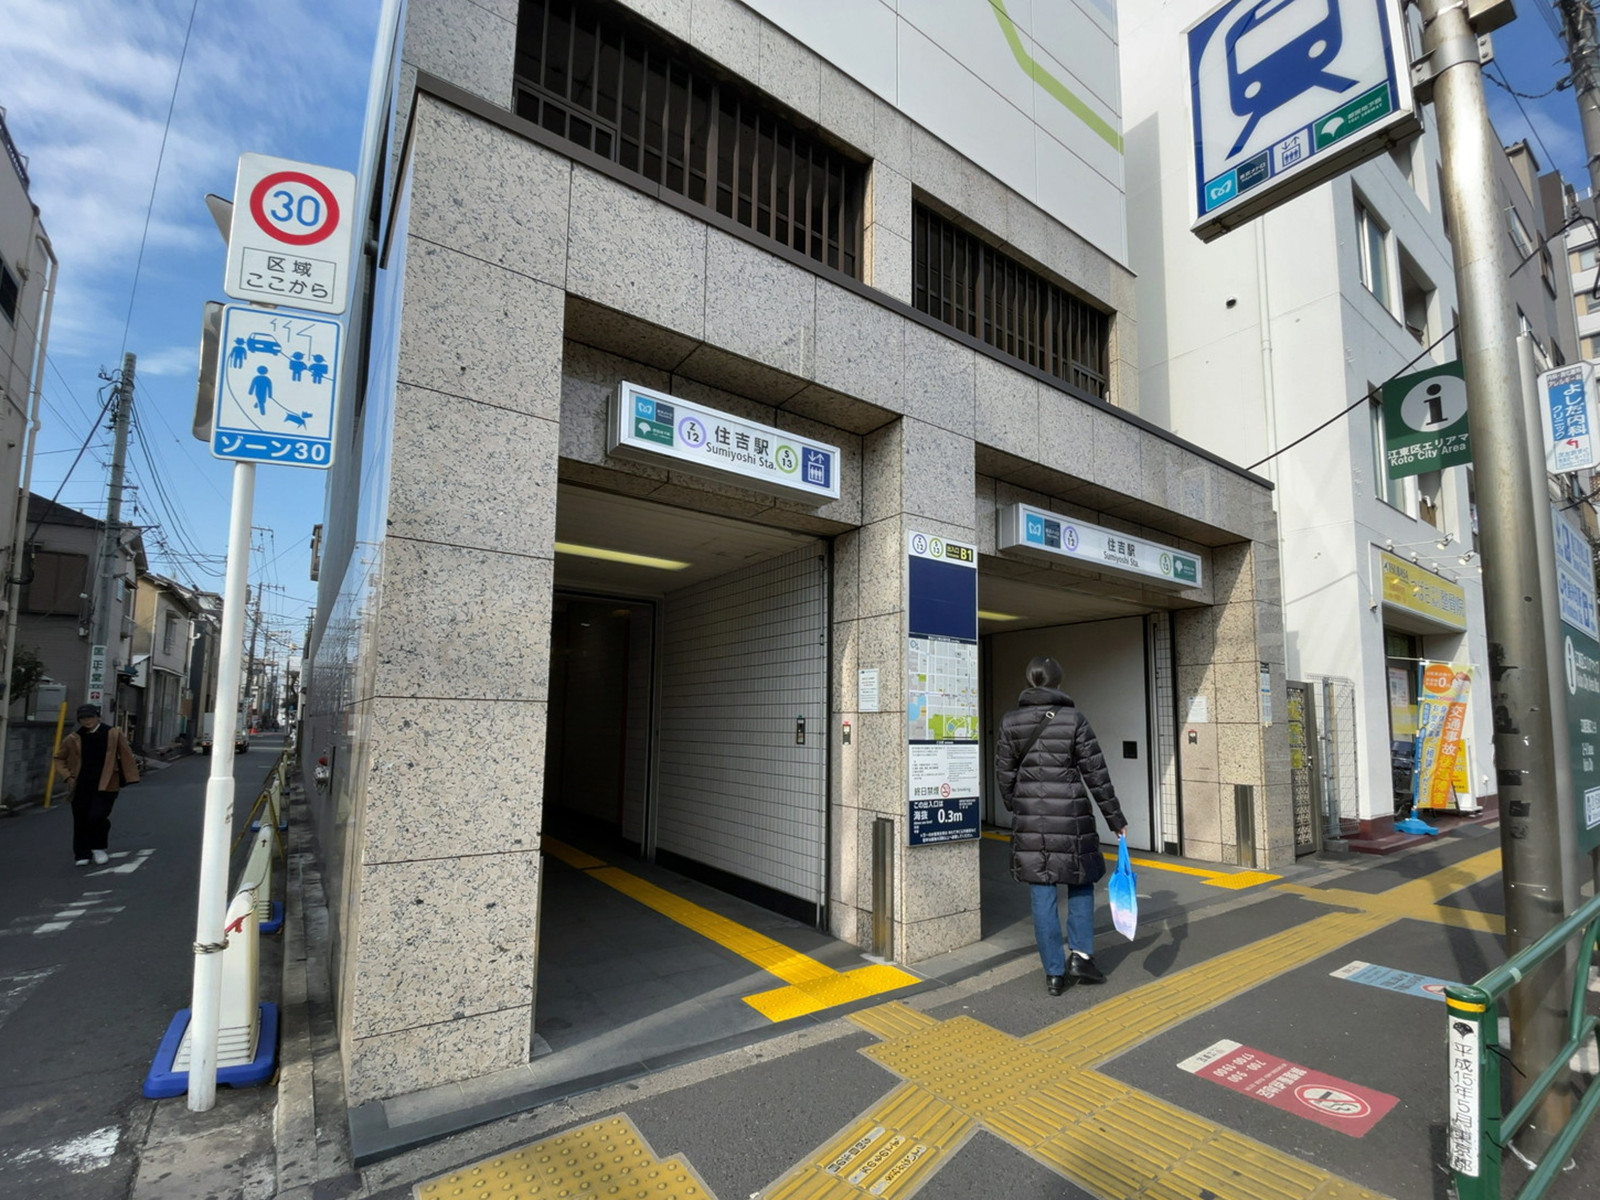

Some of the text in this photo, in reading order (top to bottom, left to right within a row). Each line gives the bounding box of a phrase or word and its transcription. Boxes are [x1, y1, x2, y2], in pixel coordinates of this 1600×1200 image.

[270, 190, 320, 227] 30
[267, 256, 312, 277] 区域
[246, 273, 328, 299] ここから
[1563, 383, 1588, 437] よしだ内科
[689, 422, 696, 431] Z
[1552, 405, 1566, 440] クリニック
[687, 431, 700, 443] 12
[714, 425, 769, 457] 住吉駅
[220, 435, 325, 461] ゾーン30
[706, 440, 777, 471] Sumiyoshi Sta.
[784, 450, 790, 459] S
[1391, 443, 1466, 467] Koto City Area
[782, 458, 793, 469] 13
[960, 547, 972, 561] B1
[1107, 537, 1136, 557] 住吉駅
[1104, 551, 1130, 566] Sumiyoshi
[913, 800, 944, 809] この出入口は
[937, 808, 963, 824] 0.3m
